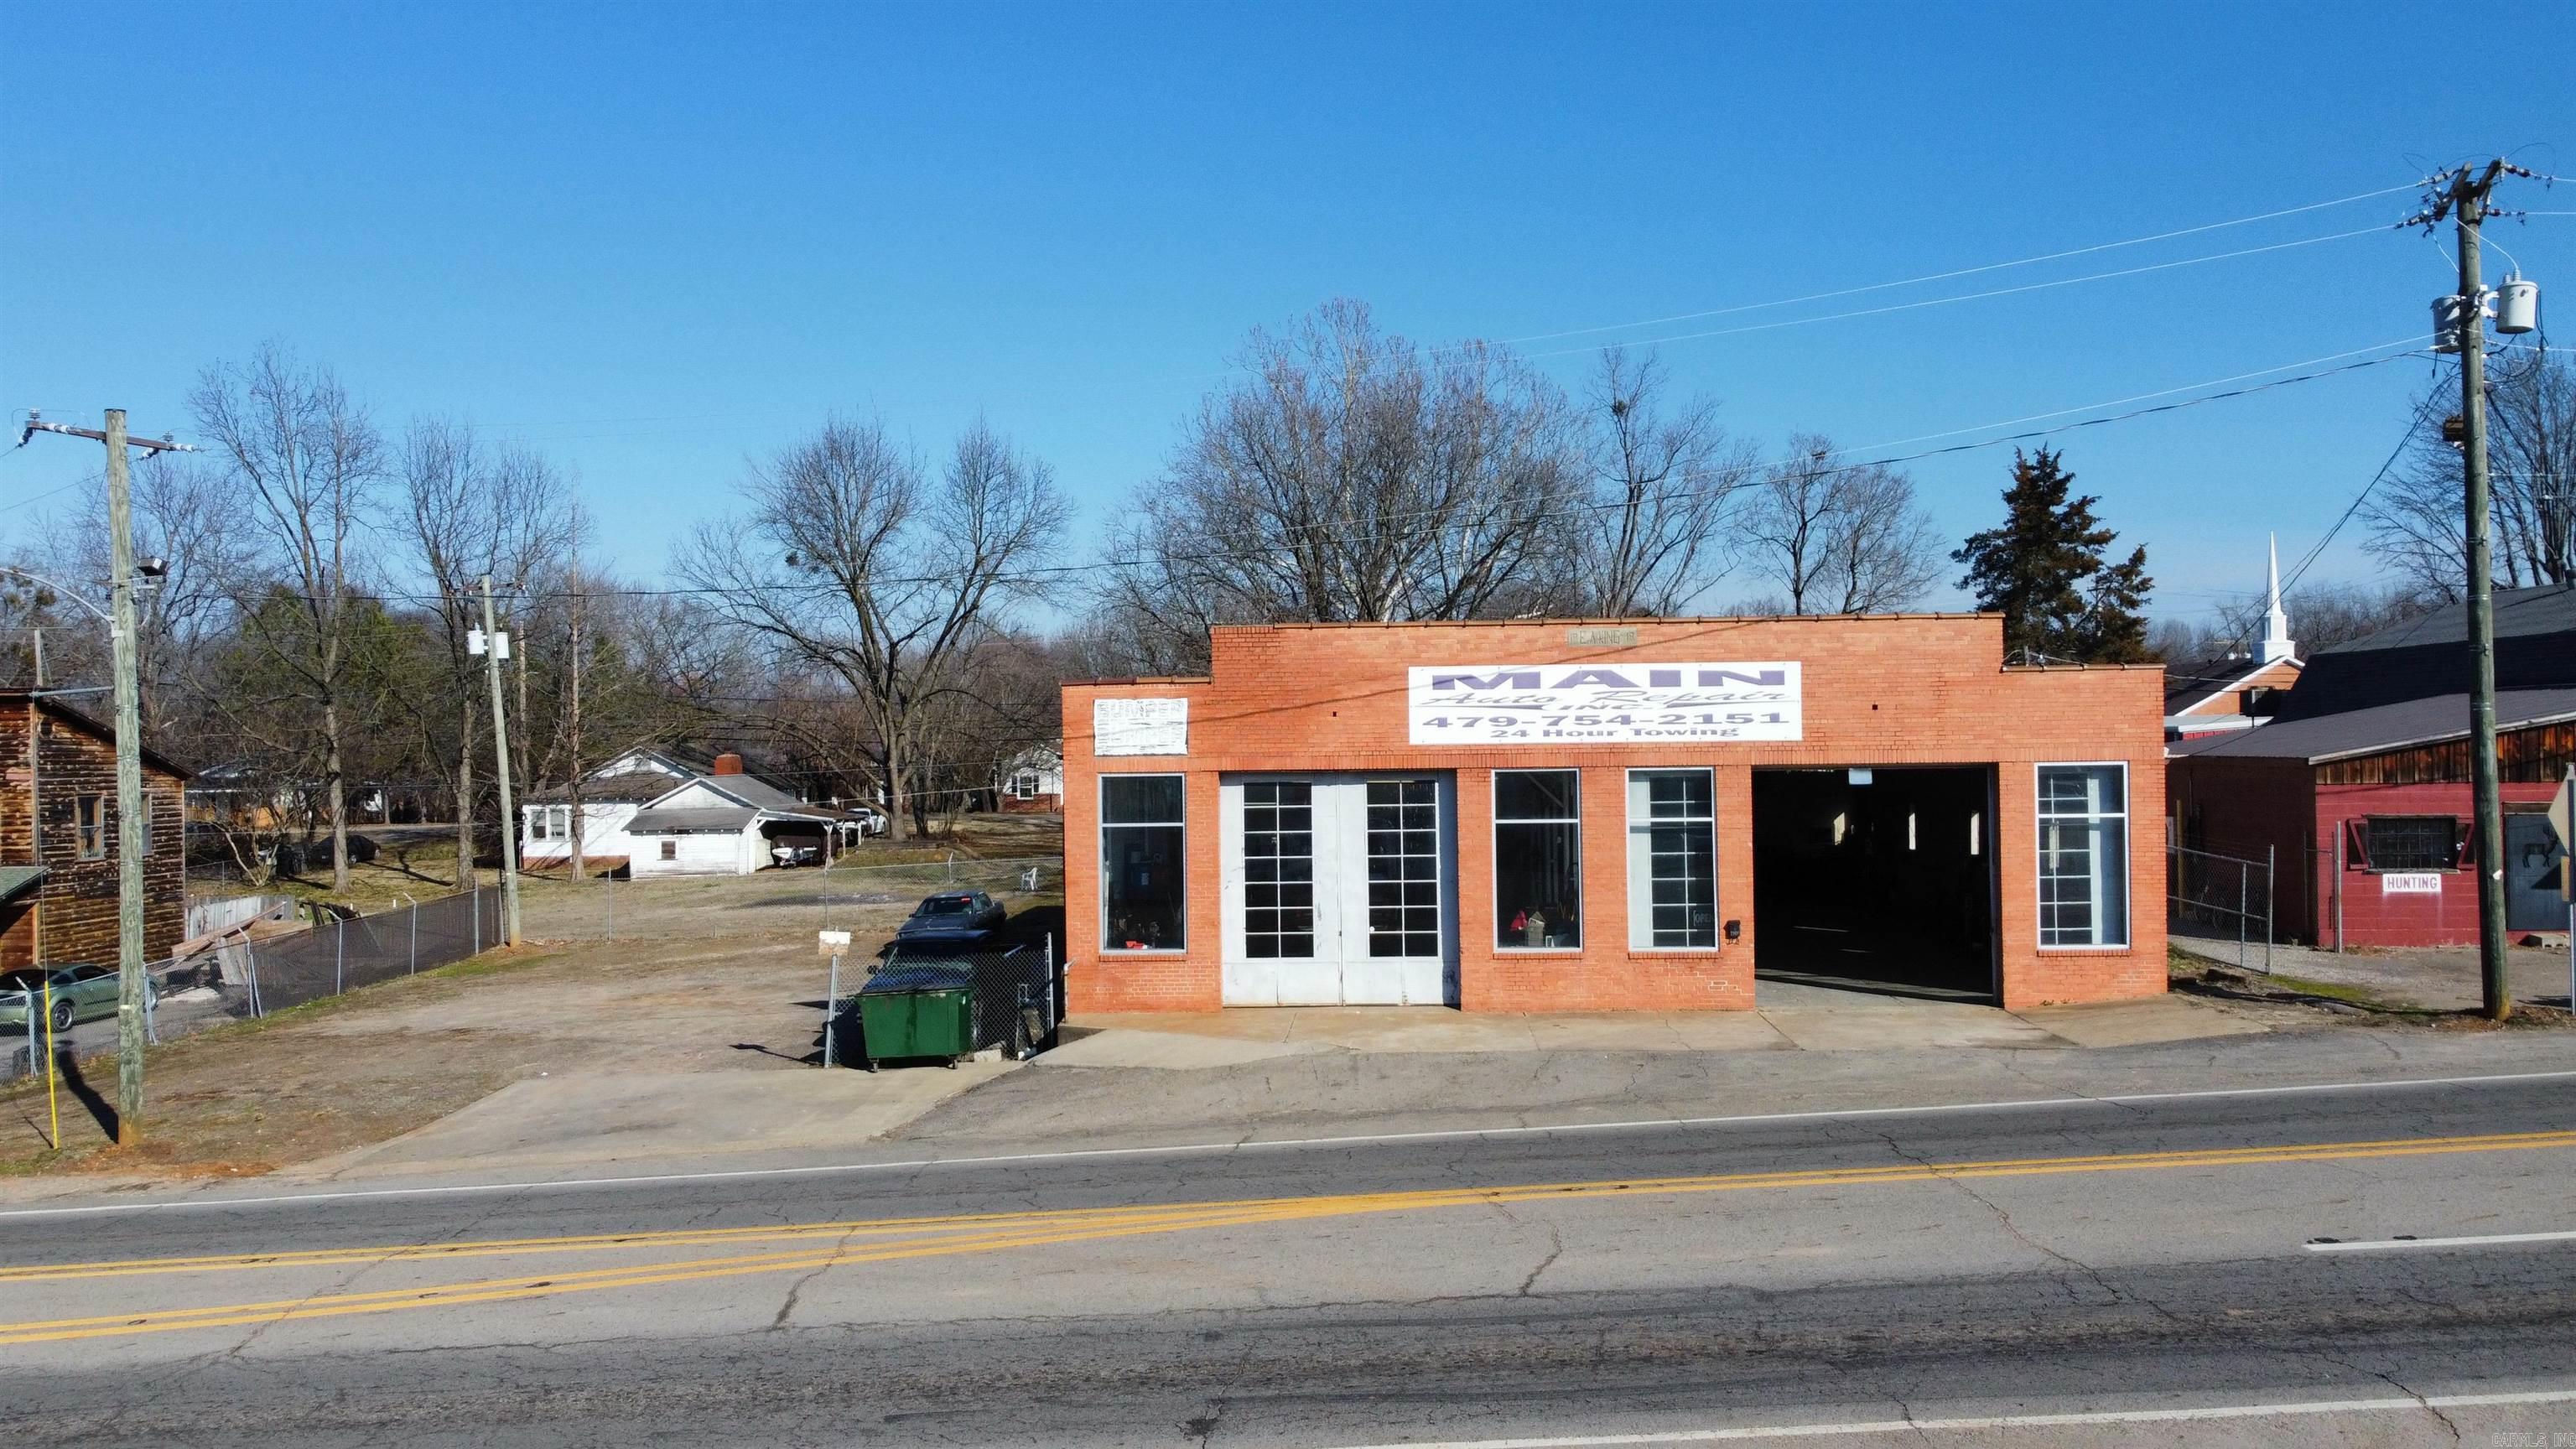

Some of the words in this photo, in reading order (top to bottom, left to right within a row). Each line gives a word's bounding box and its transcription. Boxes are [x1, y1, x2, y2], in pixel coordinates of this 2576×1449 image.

[1432, 669, 1785, 690] MAIN
[1421, 692, 1557, 704] Auto
[1588, 690, 1790, 704] Repair
[1422, 713, 1789, 728] 479-754-2151
[1490, 730, 1530, 738] 24
[1543, 729, 1618, 737] Hour
[1629, 727, 1740, 737] Towing
[2387, 876, 2438, 889] HUNTING
